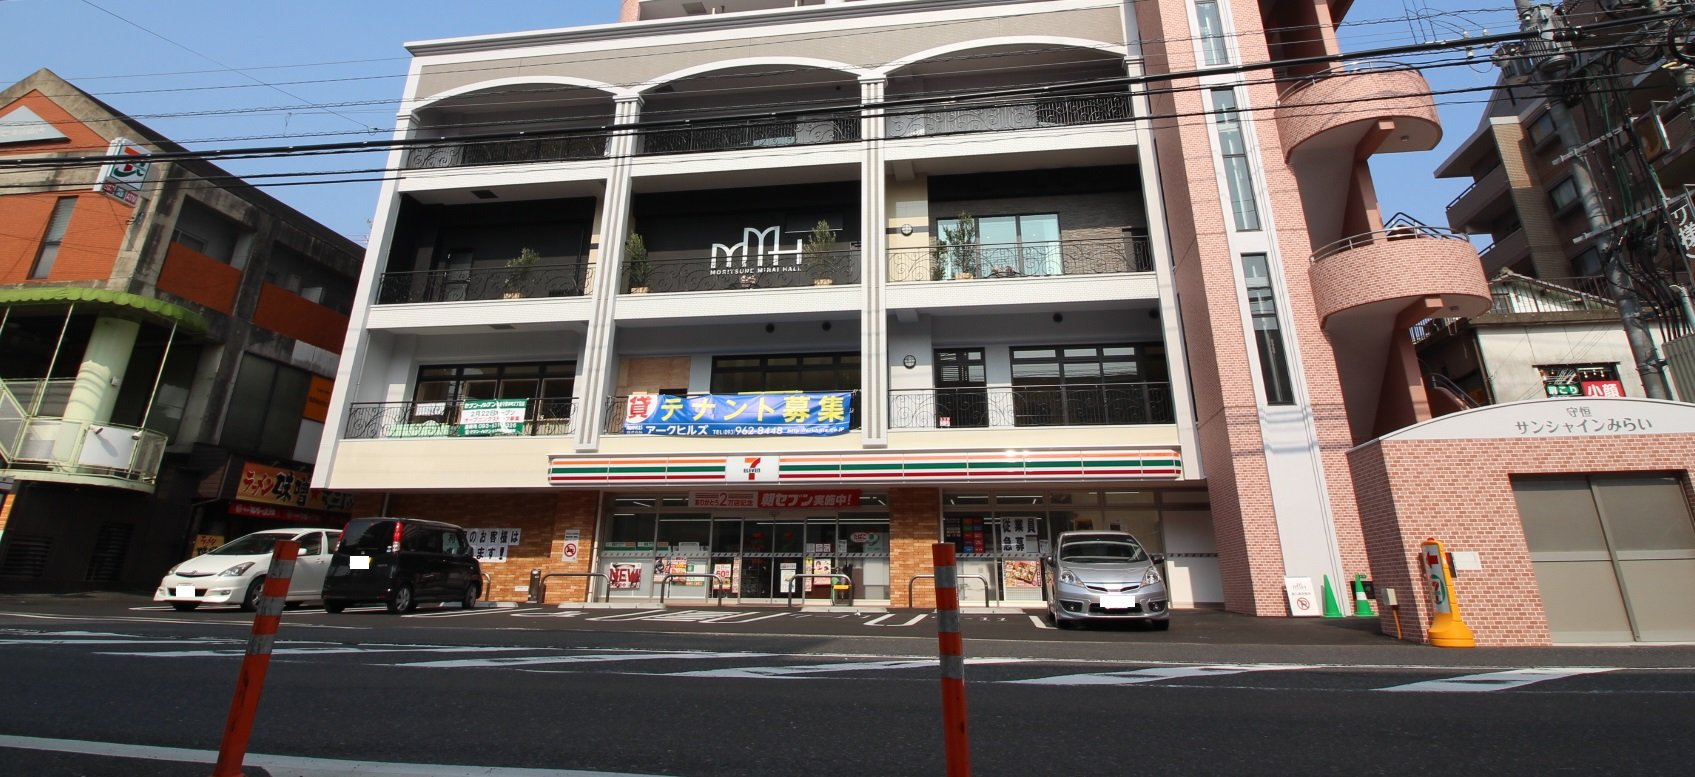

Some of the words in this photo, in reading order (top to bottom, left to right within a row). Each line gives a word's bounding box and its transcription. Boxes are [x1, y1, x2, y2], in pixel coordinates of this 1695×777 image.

[1587, 383, 1620, 398] 小顔
[628, 396, 652, 419] 貸
[660, 395, 845, 423] テナント募集
[1566, 406, 1592, 418] 守恒
[645, 424, 709, 436] アークヒルズ
[735, 425, 783, 436] 962-8448
[1514, 417, 1653, 435] サンシャインみらい
[1002, 518, 1036, 533] 従業員
[1003, 536, 1025, 552] 急募
